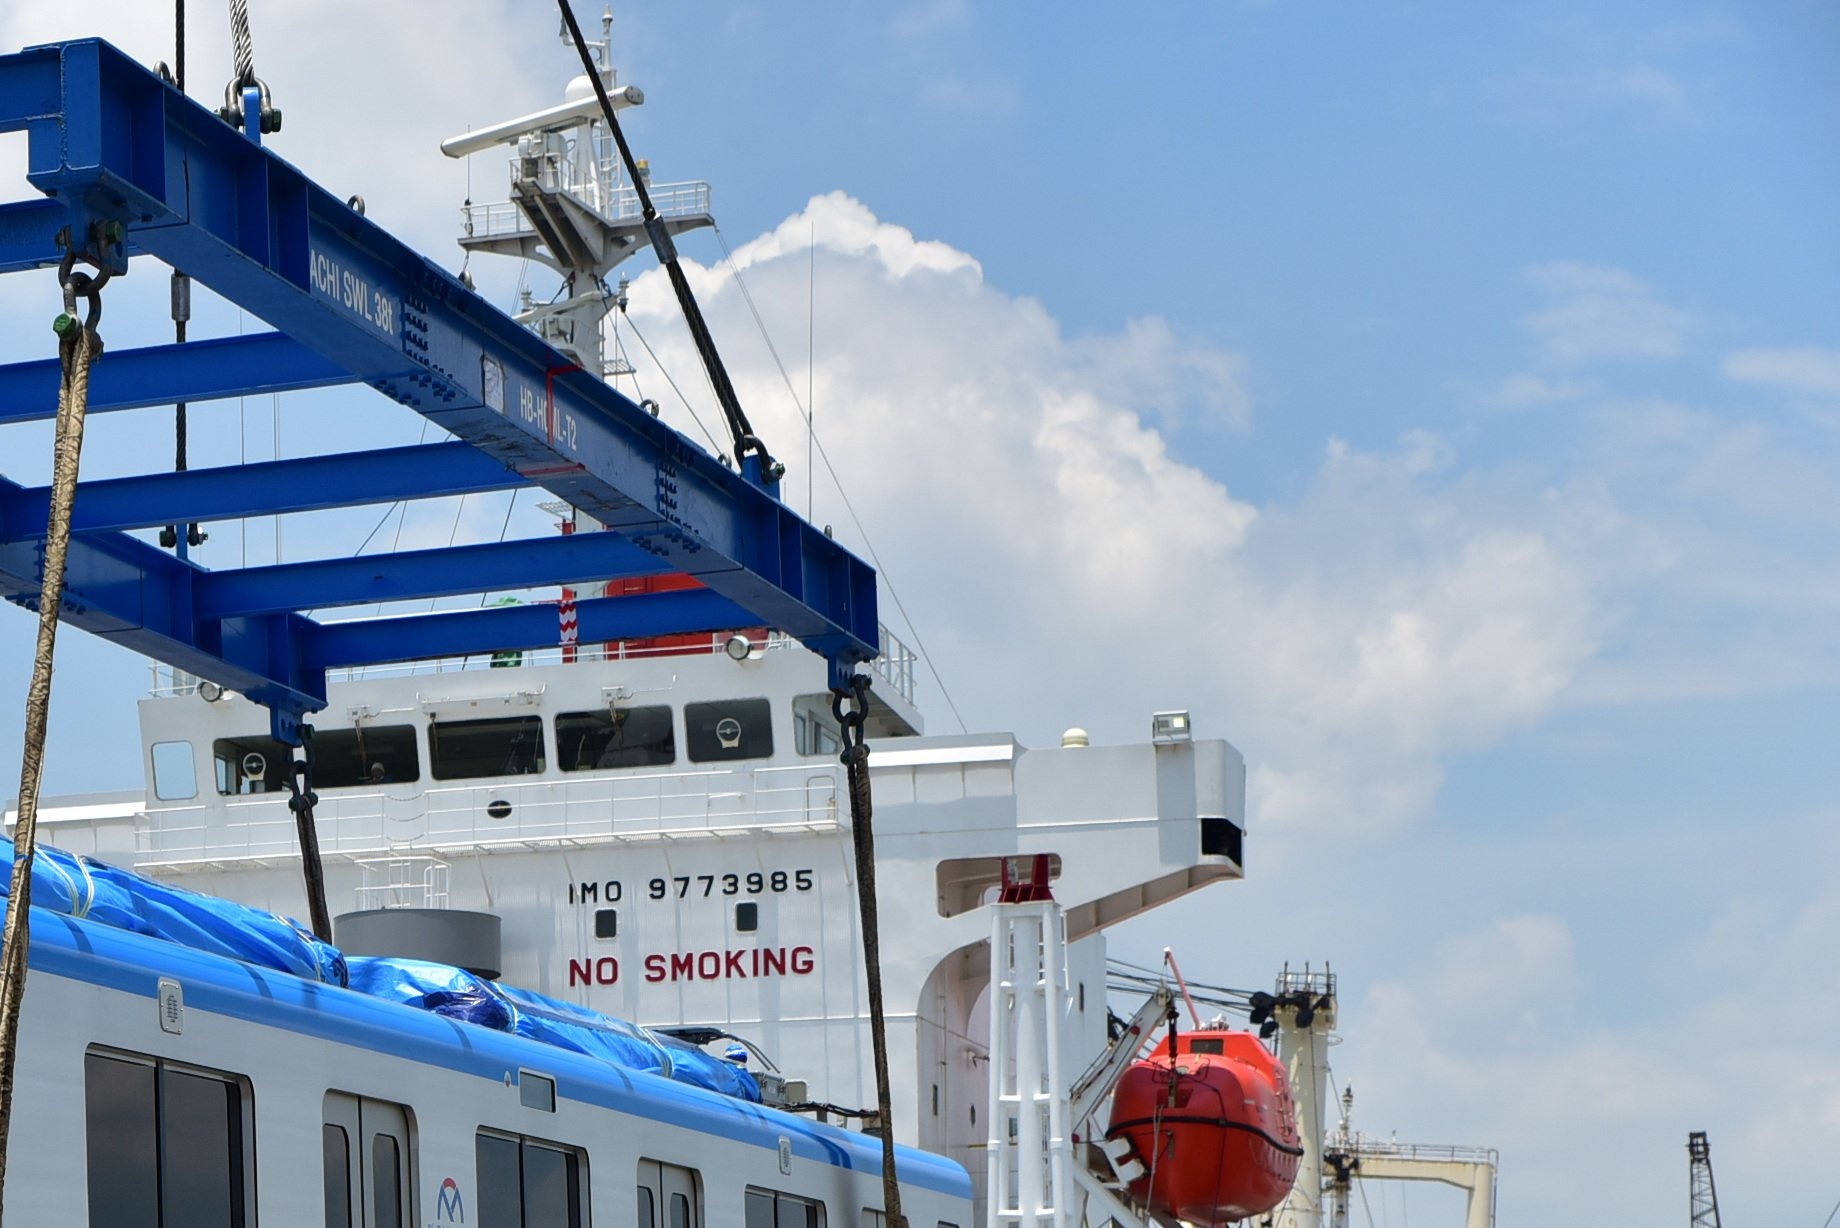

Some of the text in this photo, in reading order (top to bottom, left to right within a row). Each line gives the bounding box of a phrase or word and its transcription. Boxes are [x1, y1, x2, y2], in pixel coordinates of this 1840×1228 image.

[343, 270, 372, 321] SWL
[374, 292, 394, 336] 38t
[568, 869, 814, 904] IMO 9773985
[568, 946, 815, 987] NO SMOKING
